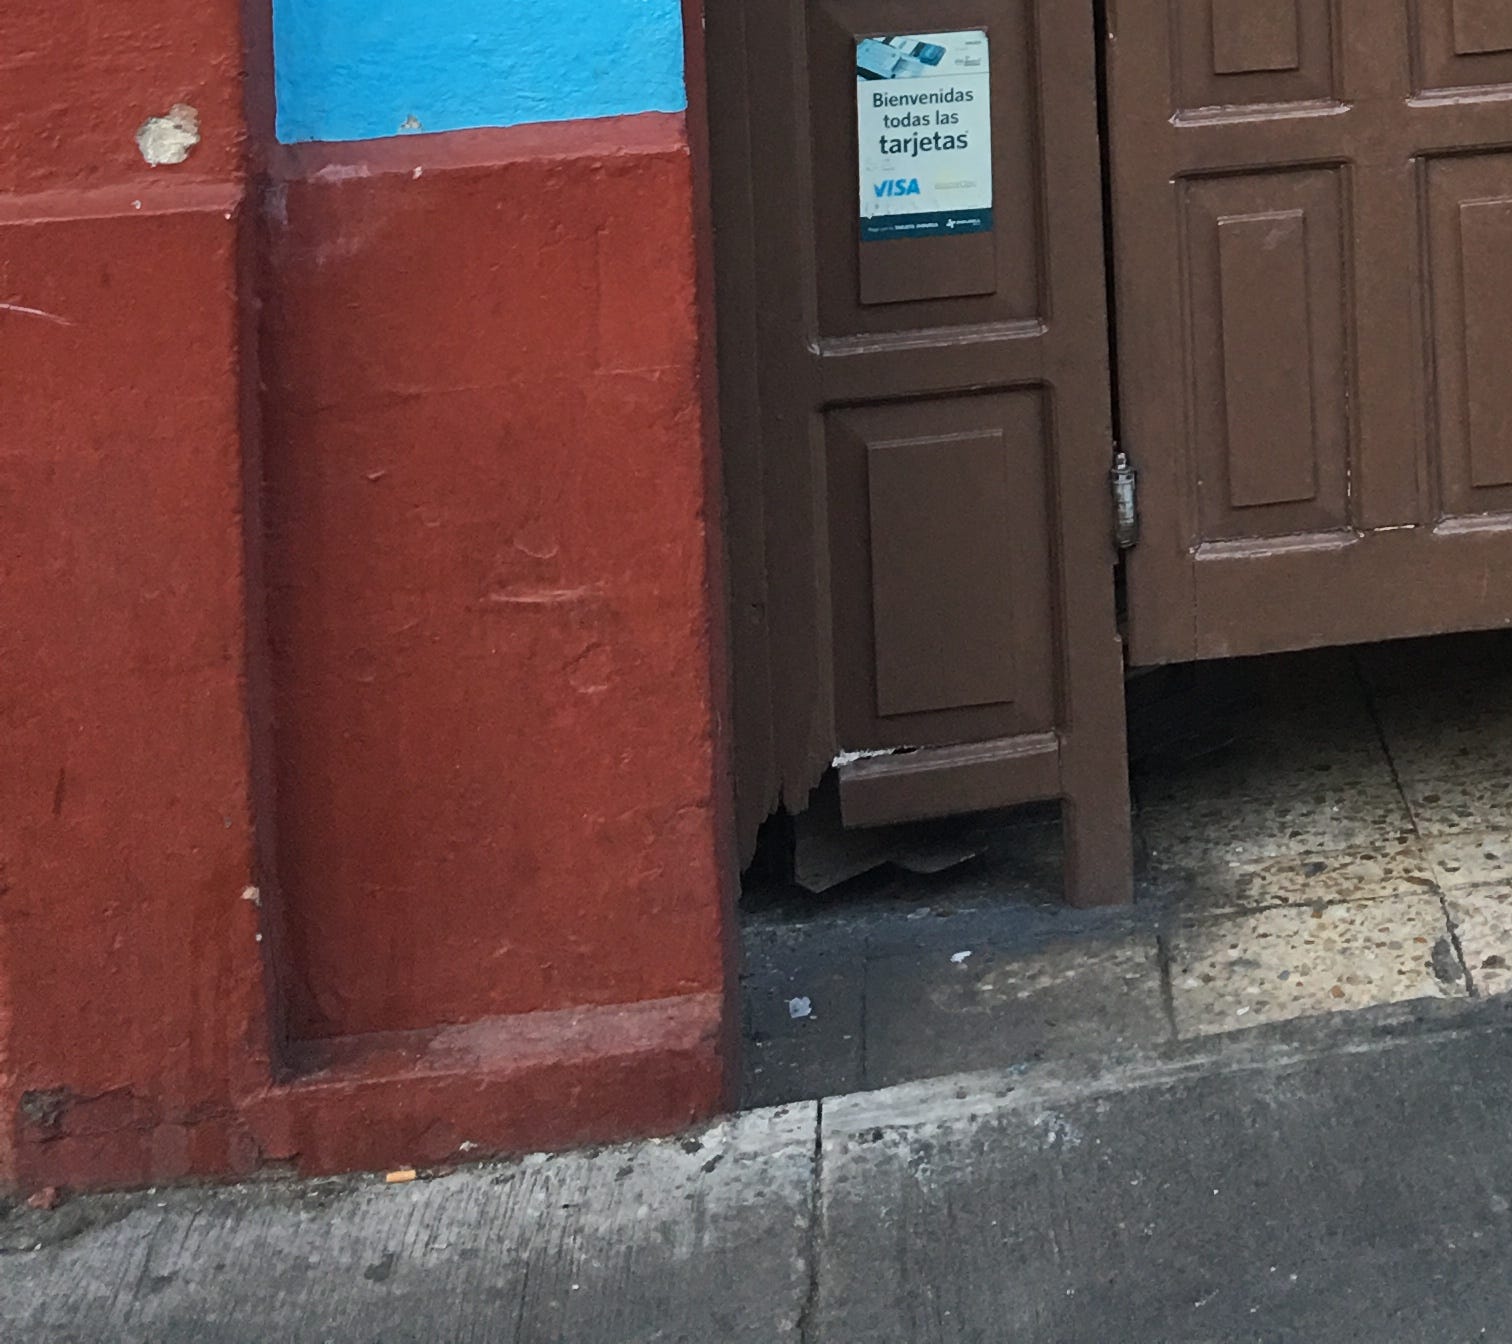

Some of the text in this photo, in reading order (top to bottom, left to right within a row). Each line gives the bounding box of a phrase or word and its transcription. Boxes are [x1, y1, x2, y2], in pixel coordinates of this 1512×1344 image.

[873, 88, 974, 108] Bienvenidas
[883, 110, 959, 128] todas las
[879, 131, 968, 157] tarjetas
[874, 178, 920, 197] VISA
